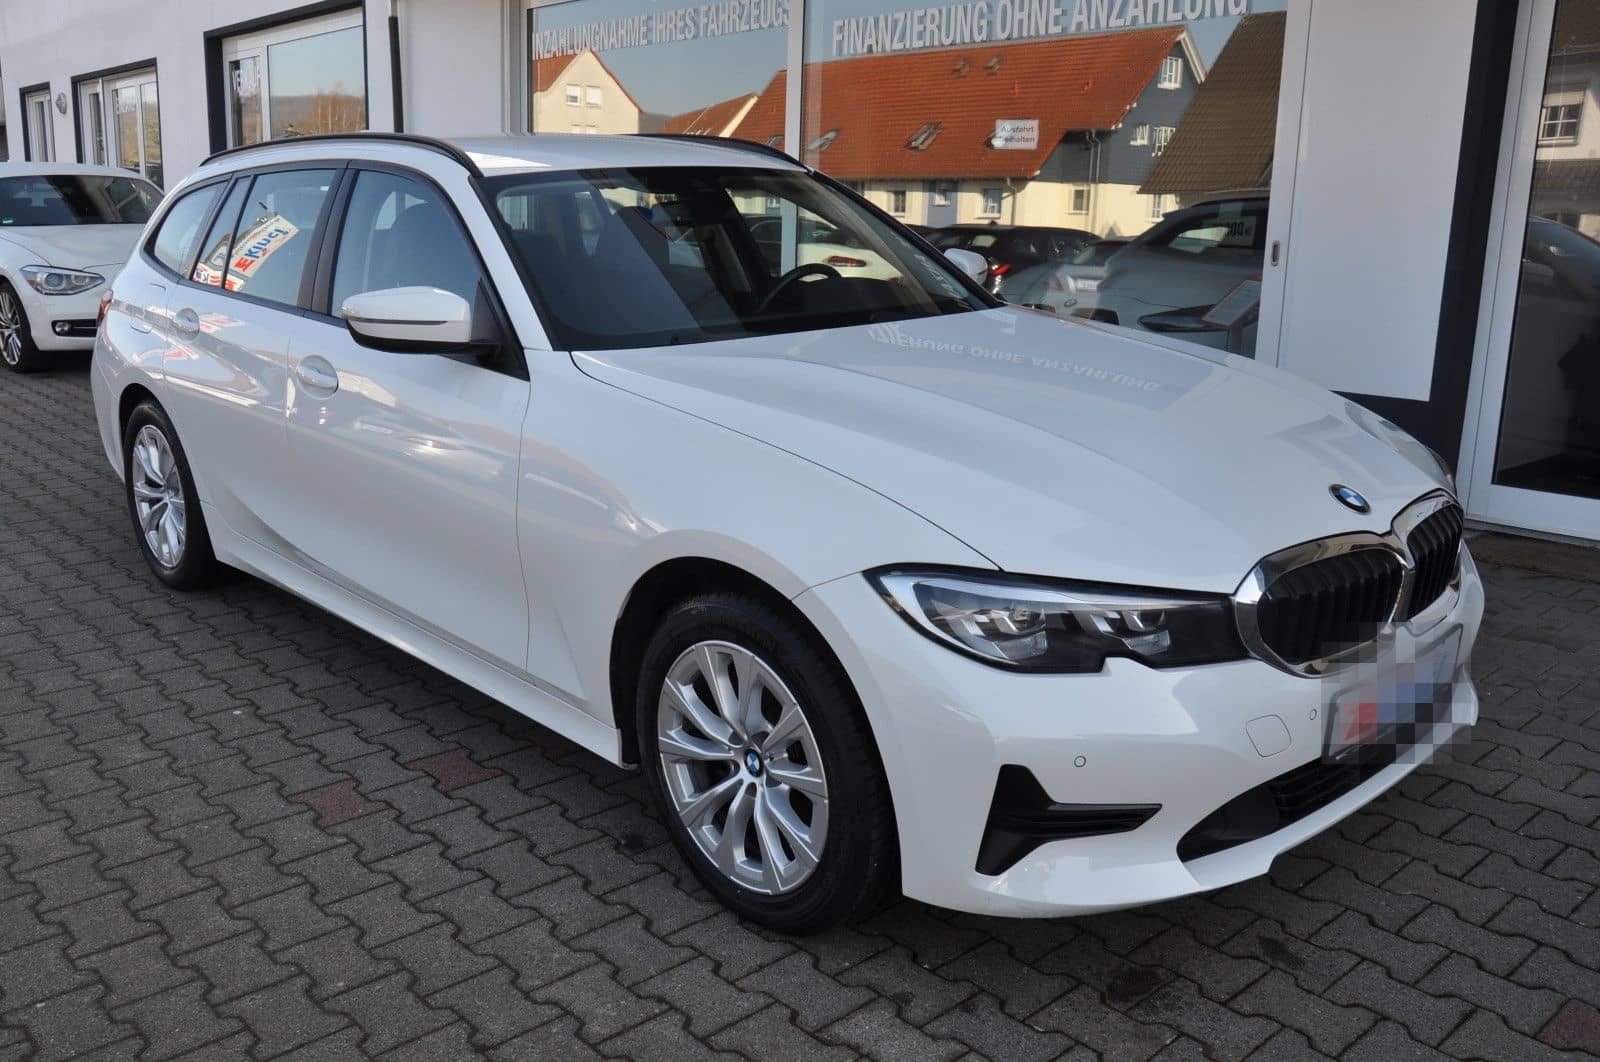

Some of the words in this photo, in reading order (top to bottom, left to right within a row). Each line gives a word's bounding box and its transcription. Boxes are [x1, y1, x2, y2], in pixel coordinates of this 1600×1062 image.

[532, 15, 648, 60] INZAHLUNGNAHME
[653, 8, 695, 43] IHRES
[833, 1, 989, 56] FINANZIERUNG
[997, 0, 1063, 39] OHNE
